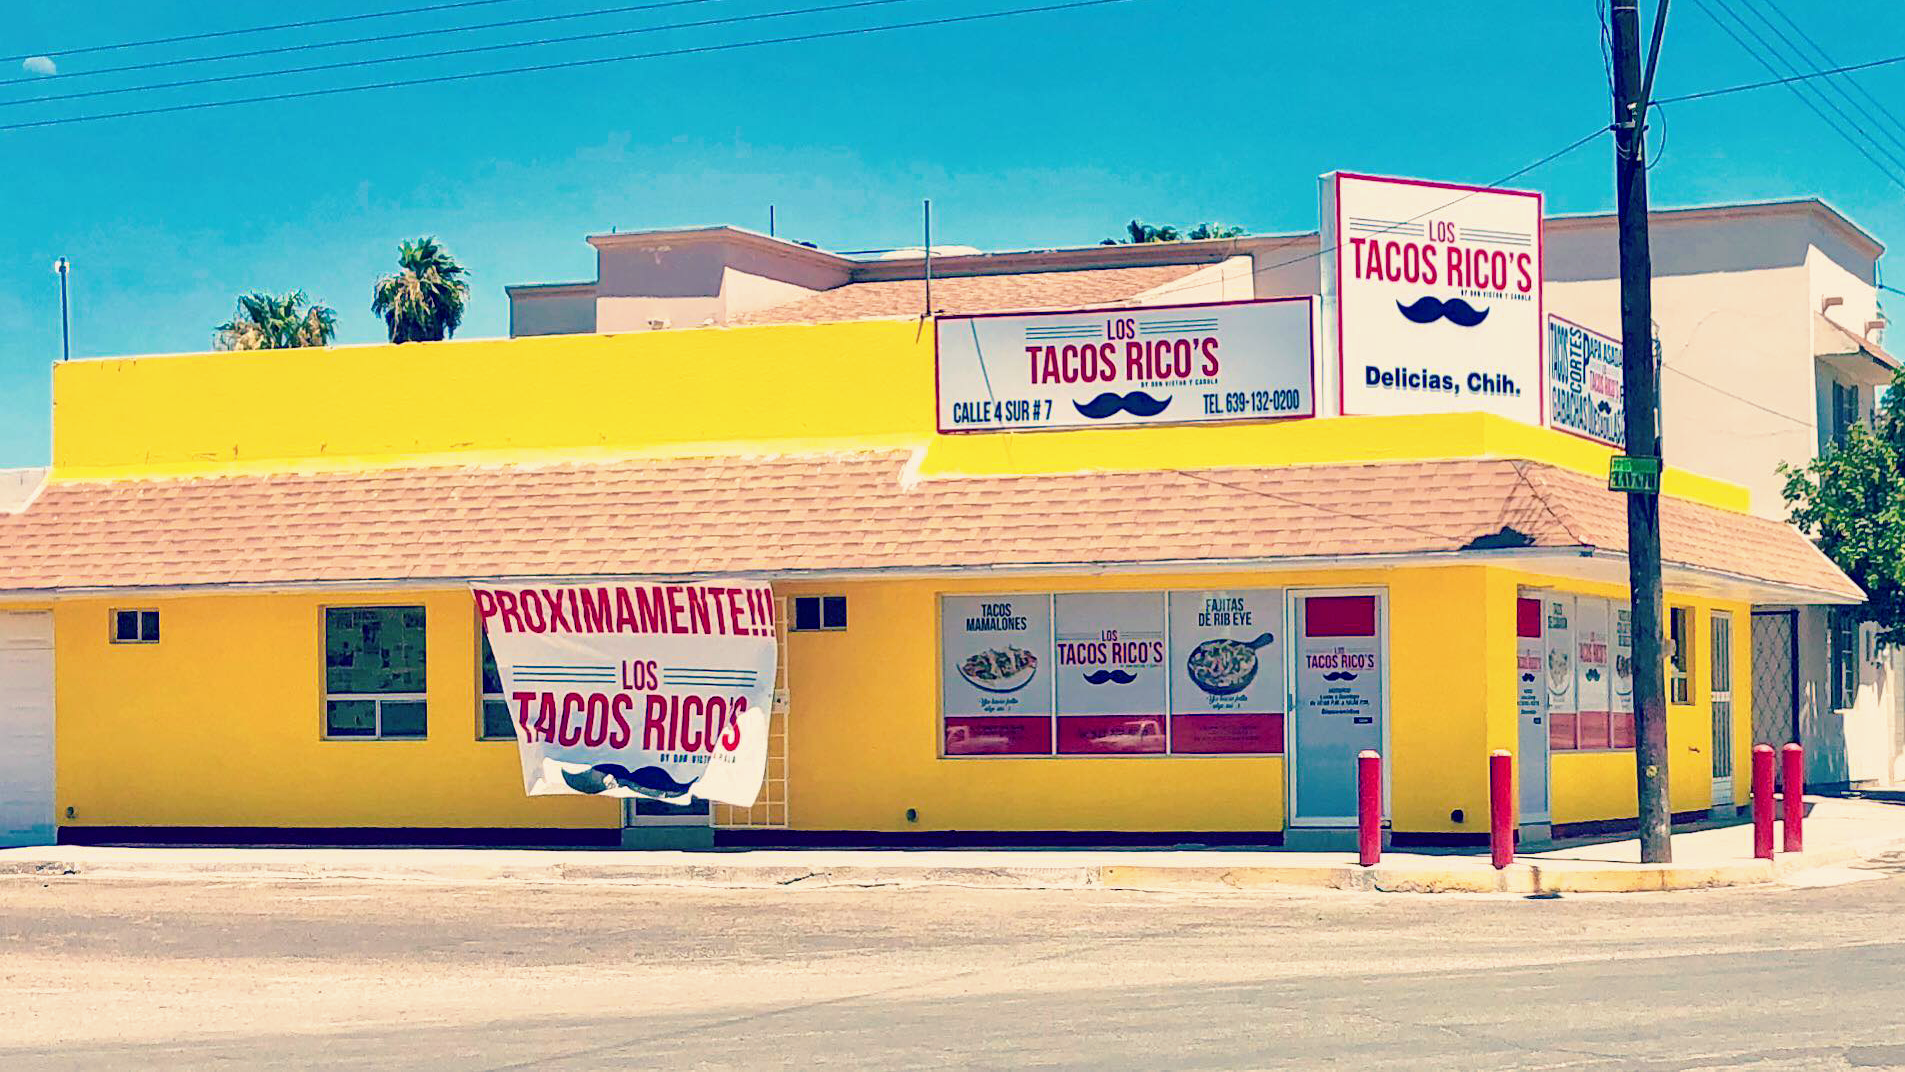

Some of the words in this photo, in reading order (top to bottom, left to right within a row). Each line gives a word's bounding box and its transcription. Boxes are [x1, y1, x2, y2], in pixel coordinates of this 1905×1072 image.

[1429, 220, 1455, 243] LOS
[1350, 237, 1437, 285] TACOS
[1447, 246, 1532, 293] RICO'S
[1107, 318, 1135, 340] LOS
[1025, 342, 1116, 385] TACOS
[1126, 337, 1220, 381] RICO'S
[1570, 326, 1582, 394] CORTES
[1365, 365, 1460, 394] Delicias,
[1467, 373, 1522, 395] Chih.
[953, 400, 991, 423] CALLE
[993, 401, 1002, 421] 4
[1005, 399, 1030, 422] SUR
[1044, 399, 1052, 420] 7
[1203, 394, 1224, 414] TEL.
[1226, 389, 1300, 413] 639-132-0200
[474, 586, 776, 637] PROXIMAMENTE!!!
[981, 603, 1012, 618] TACOS
[1205, 598, 1244, 612] FAJITAS
[966, 617, 1027, 631] MAMALONES
[1198, 612, 1212, 626] DE
[1214, 612, 1231, 626] RIB
[1233, 611, 1252, 626] EYE
[1101, 630, 1118, 641] LOS
[1057, 643, 1107, 665] TACOS
[1112, 641, 1163, 664] RICO'S
[1306, 654, 1338, 668] TACOS
[1341, 654, 1374, 668] RICO'S
[622, 660, 658, 691] LOS
[512, 691, 632, 750] TACOS
